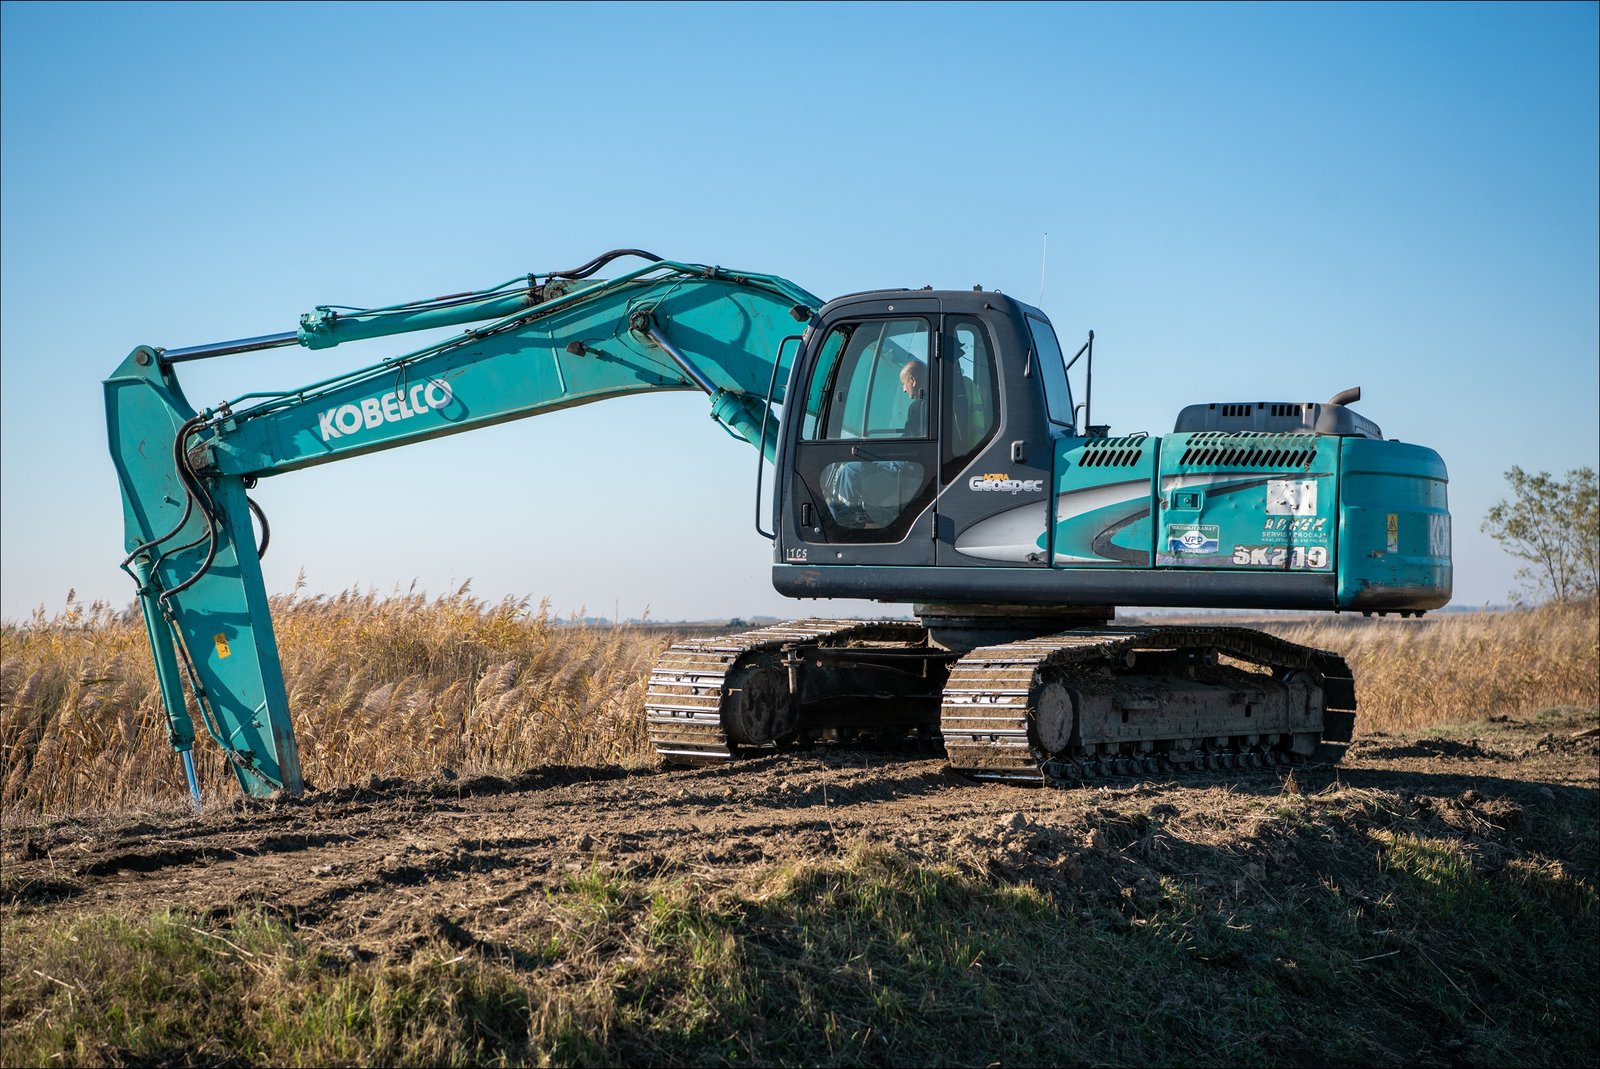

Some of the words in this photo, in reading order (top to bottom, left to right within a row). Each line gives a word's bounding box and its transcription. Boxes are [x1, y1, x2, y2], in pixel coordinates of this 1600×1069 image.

[318, 378, 453, 442] KOBELCO
[969, 476, 1043, 495] Geospec
[1184, 535, 1203, 543] VPD
[1232, 545, 1328, 568] SK210
